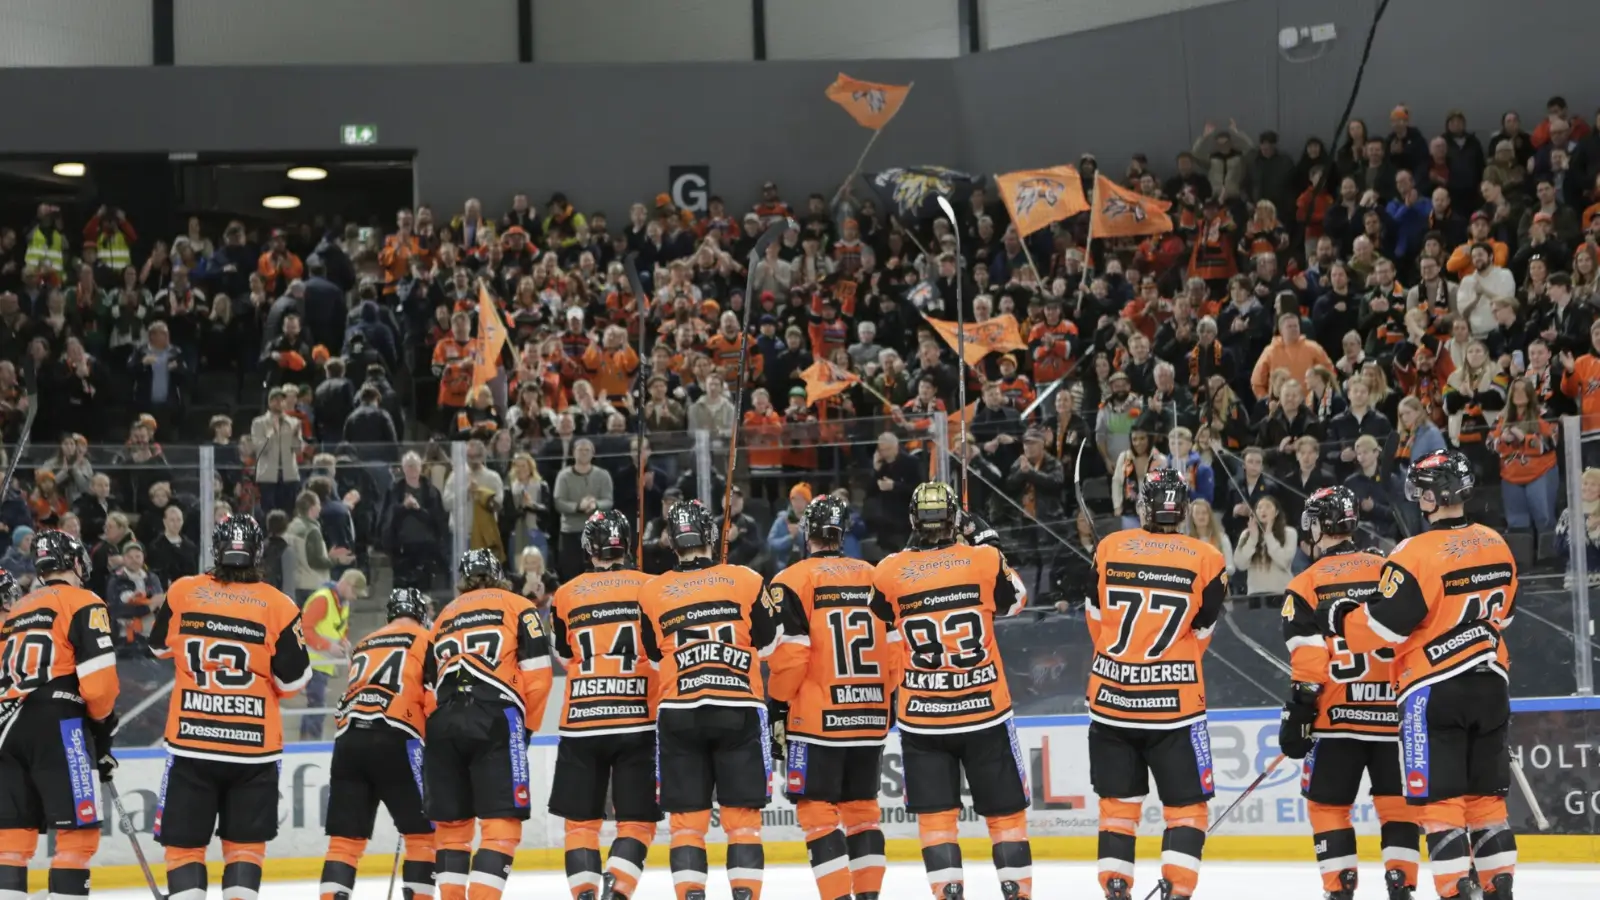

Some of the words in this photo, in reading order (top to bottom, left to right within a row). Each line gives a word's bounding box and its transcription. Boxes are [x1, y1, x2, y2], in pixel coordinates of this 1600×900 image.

[672, 173, 707, 212] G
[1165, 490, 1176, 502] 77
[831, 507, 841, 517] 12
[919, 557, 971, 570] energima
[1106, 568, 1136, 580] Orange
[1106, 587, 1191, 660] 77
[576, 621, 640, 675] 14
[826, 609, 881, 679] 12
[184, 637, 256, 690] 13
[722, 646, 752, 670] BYE
[953, 663, 997, 690] OLSEN
[1121, 663, 1196, 684] PEDERSEN
[183, 691, 264, 718] ANDRESEN
[836, 684, 884, 704] BÄCKMAN
[908, 696, 991, 714] Dressmann
[1097, 688, 1178, 709] Dressmann
[569, 704, 645, 719] Dressmann
[180, 721, 262, 743] Dressmann
[71, 728, 93, 798] SpareBank
